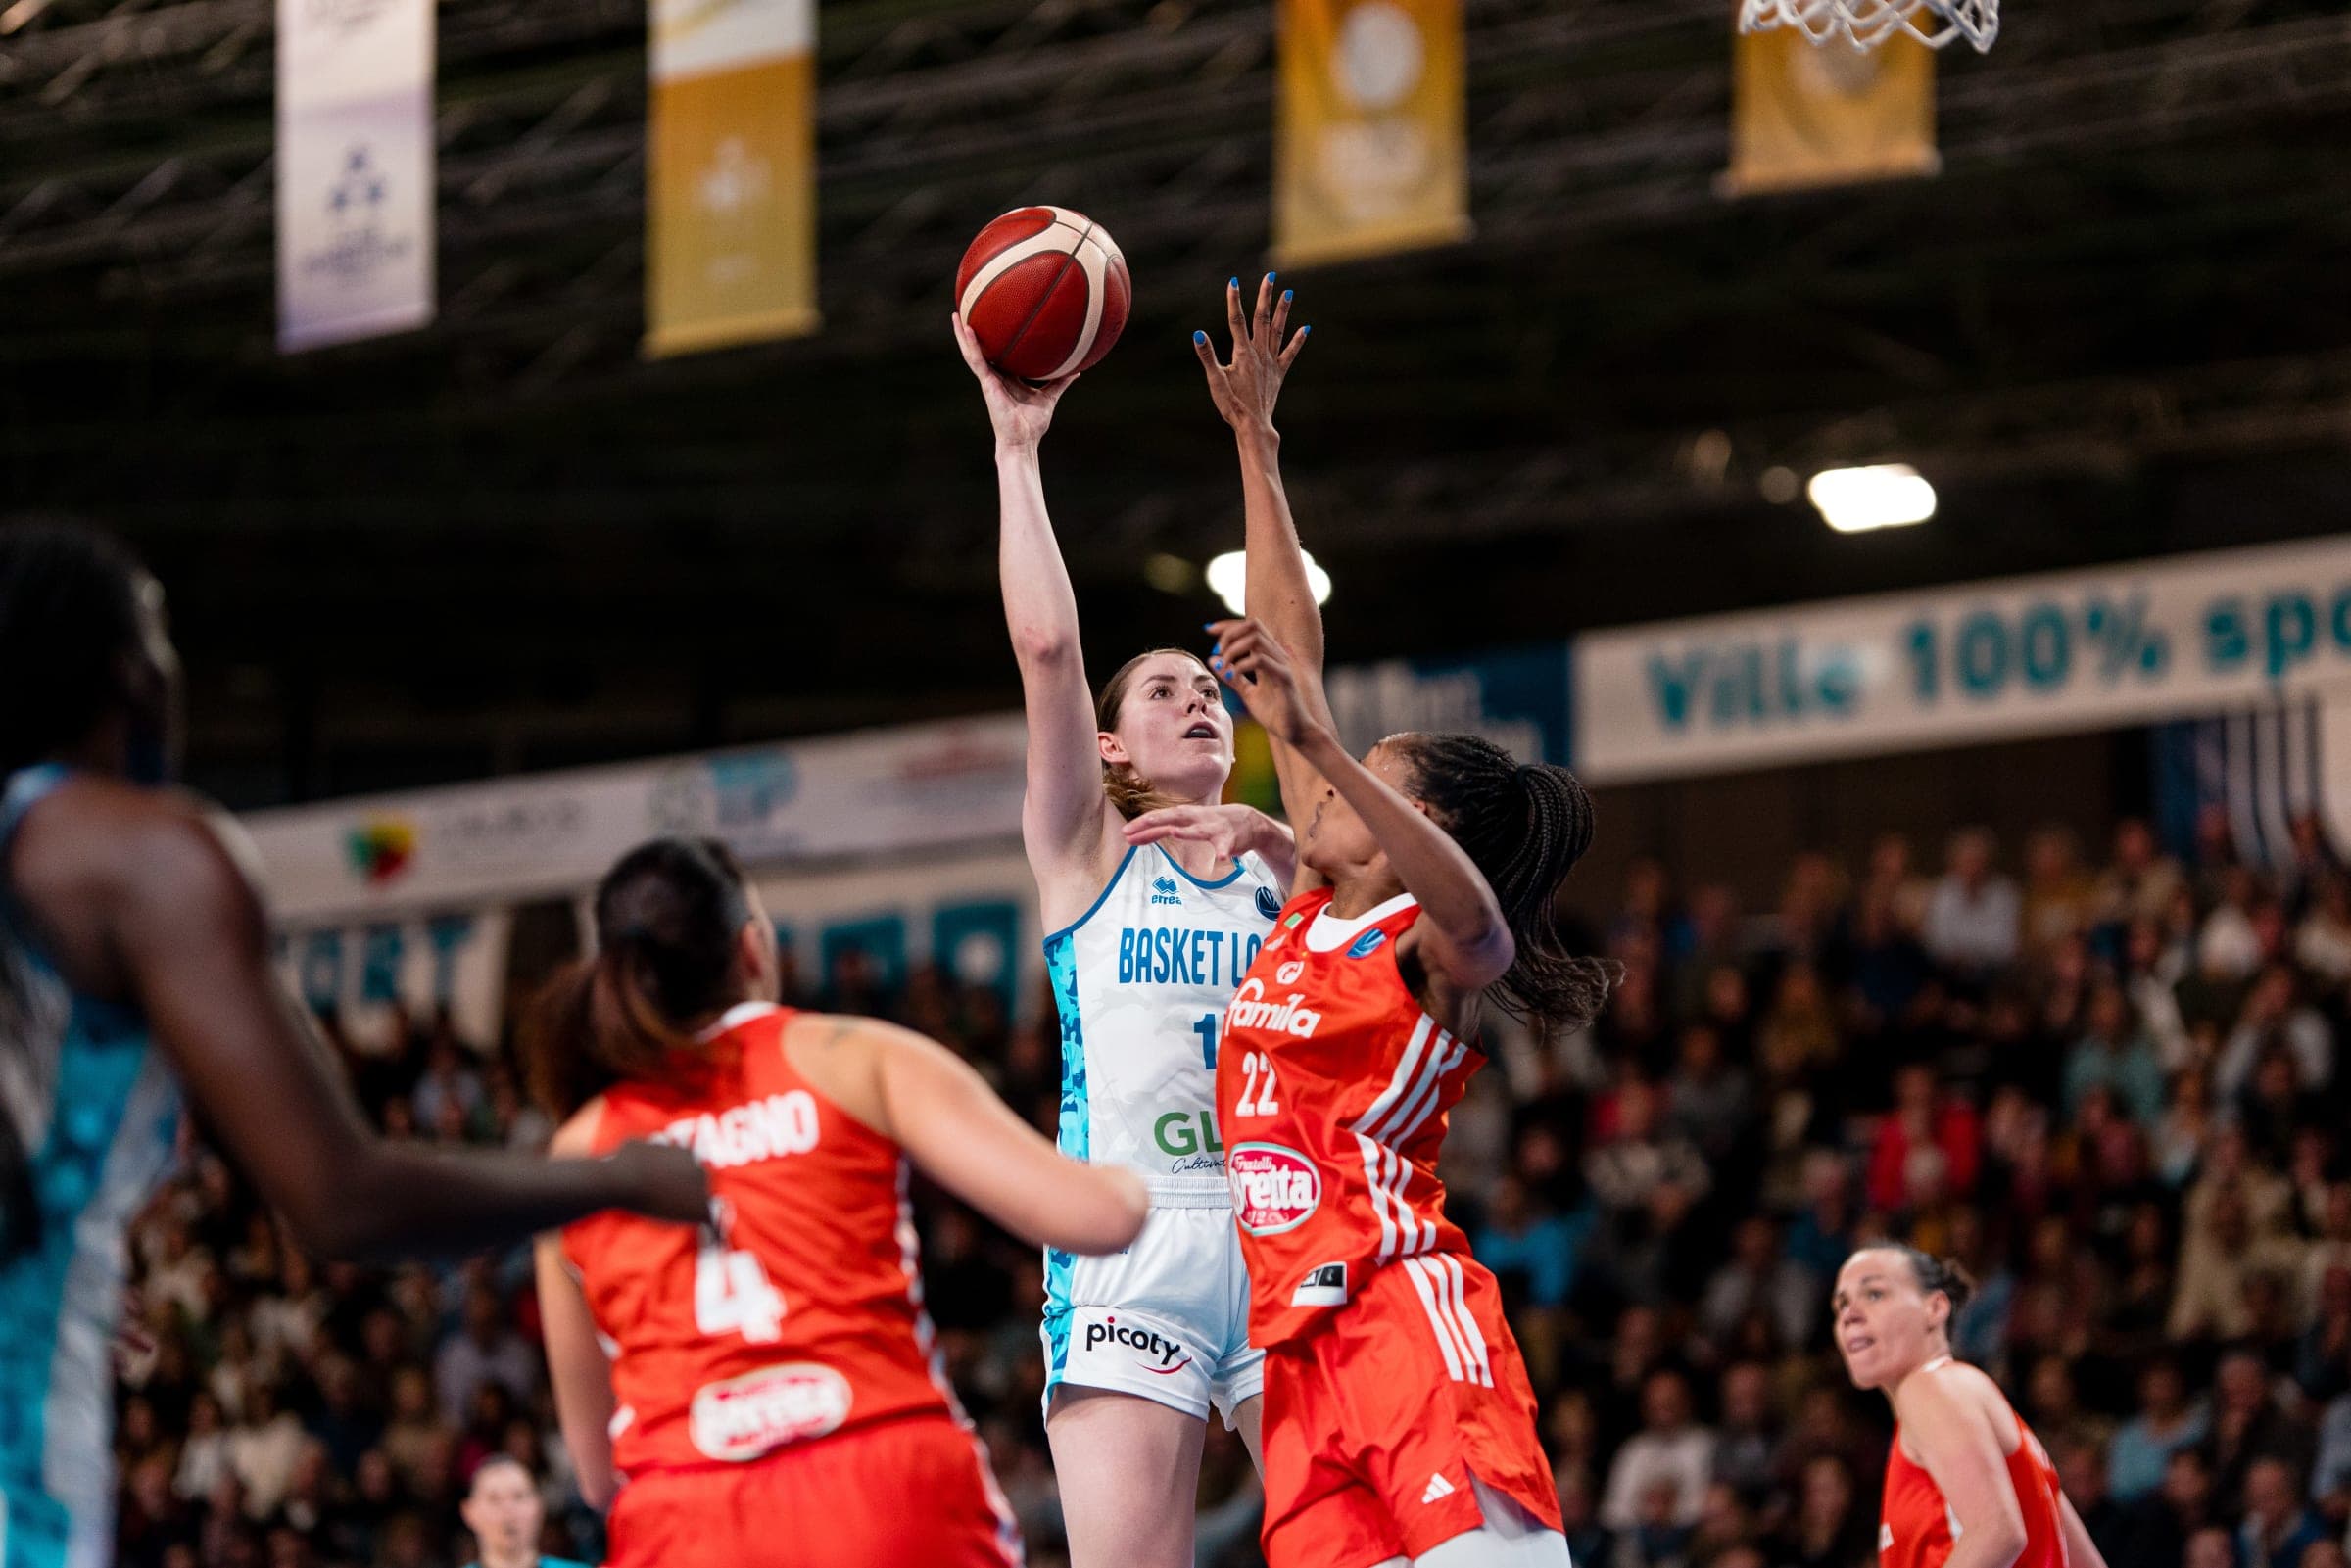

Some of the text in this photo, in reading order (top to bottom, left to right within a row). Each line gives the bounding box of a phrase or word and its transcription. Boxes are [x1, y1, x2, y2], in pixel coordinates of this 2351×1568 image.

[1647, 639, 1862, 727] Ville
[1905, 590, 2169, 705] 100%
[1119, 927, 1223, 986] BASKET
[1224, 977, 1321, 1038] famila
[1194, 1013, 1225, 1070] 1
[1235, 1050, 1279, 1117] 22
[1154, 1110, 1224, 1156] GL
[695, 1200, 787, 1343] 4
[1086, 1316, 1181, 1365] picoty
